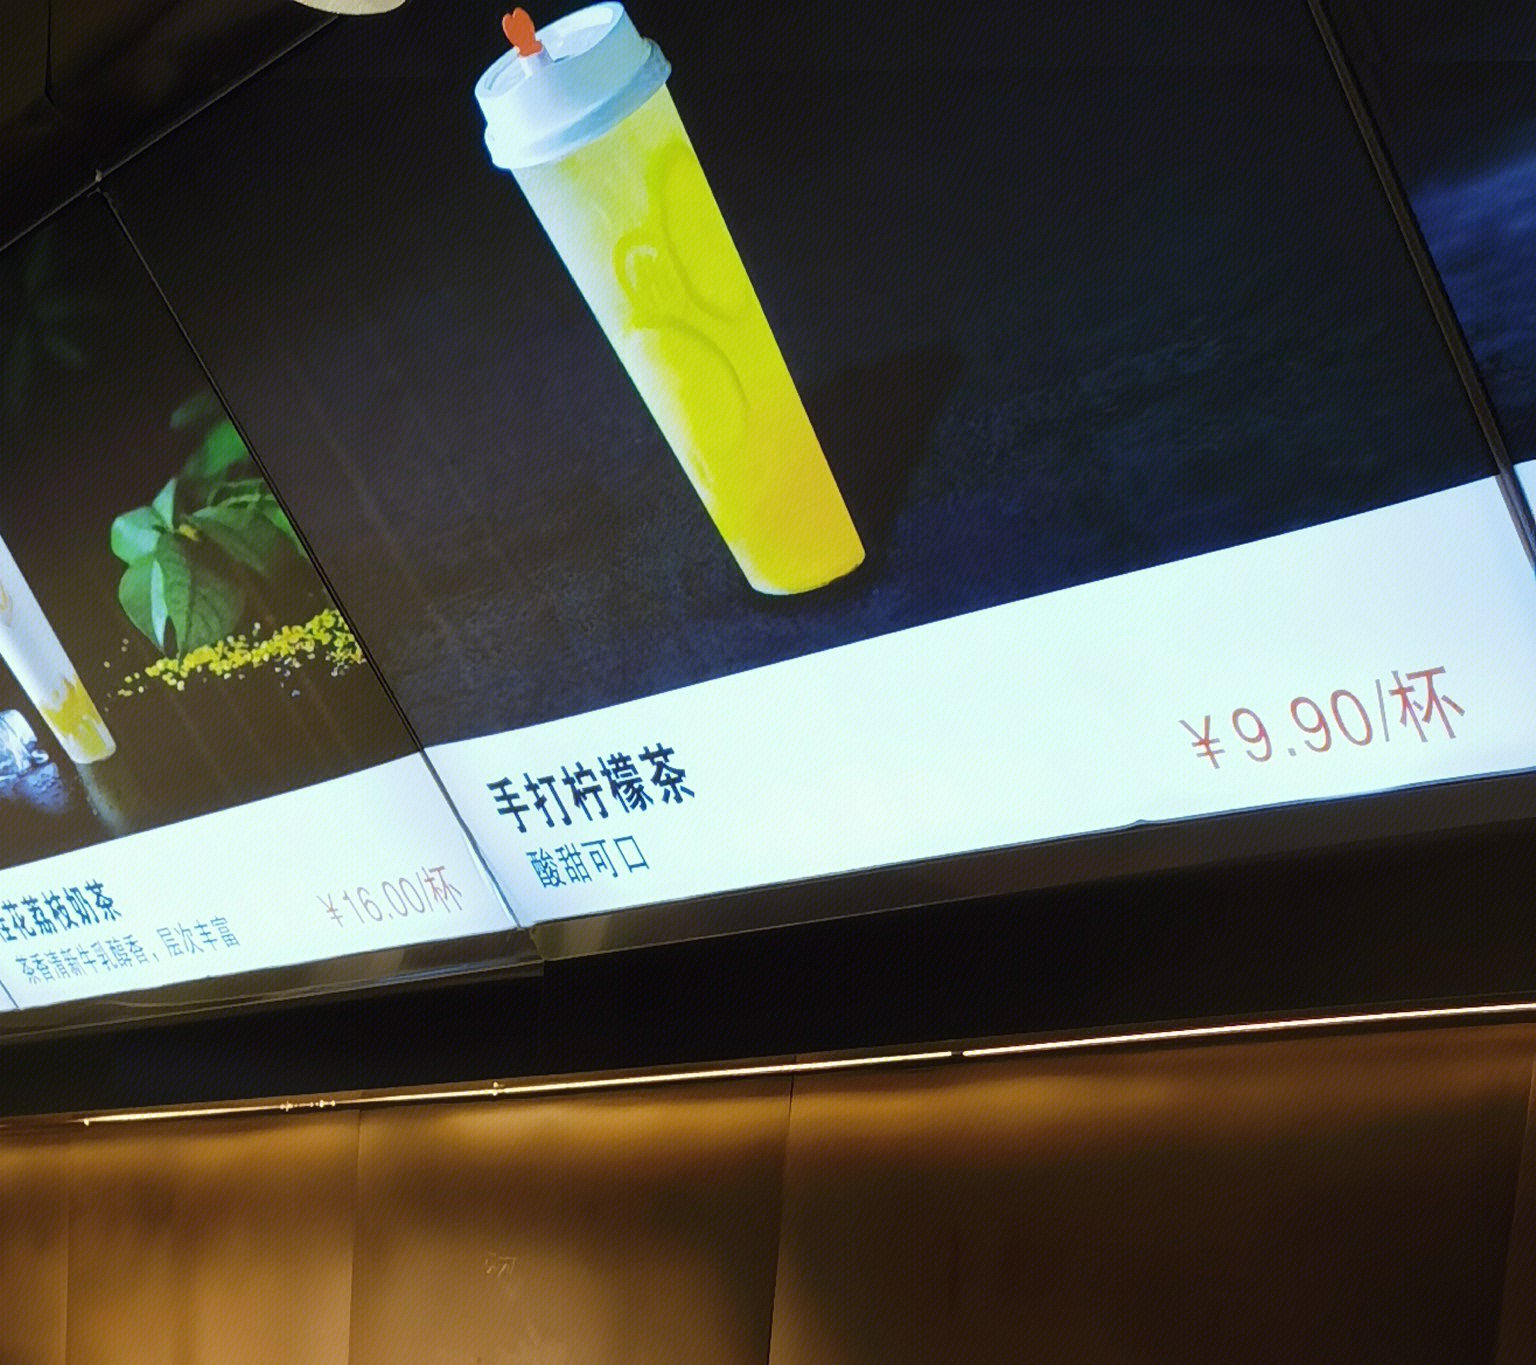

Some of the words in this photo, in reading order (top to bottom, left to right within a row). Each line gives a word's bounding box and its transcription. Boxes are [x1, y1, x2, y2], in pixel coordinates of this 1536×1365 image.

[486, 743, 695, 833] 手打柠檬茶
[526, 834, 651, 891] 酸甜可口
